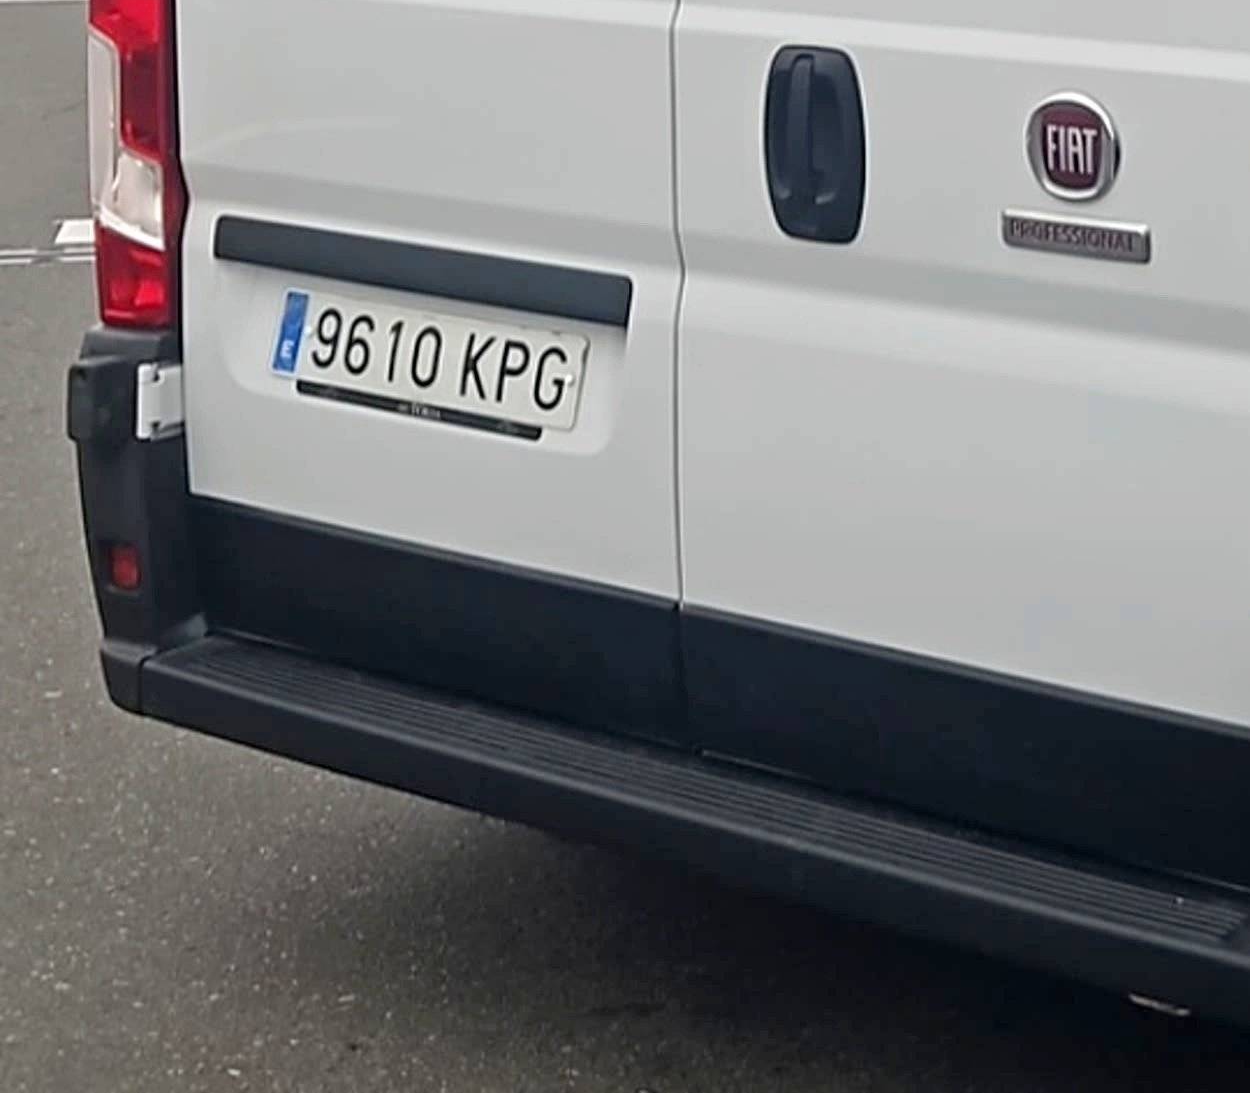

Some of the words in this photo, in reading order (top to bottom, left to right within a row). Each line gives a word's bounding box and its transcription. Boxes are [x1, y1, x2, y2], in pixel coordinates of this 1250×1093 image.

[1047, 124, 1098, 175] FIAT
[1010, 219, 1135, 252] PROFESSIONAL
[279, 339, 293, 358] E
[311, 307, 443, 388] 9610
[460, 331, 568, 411] KPG
